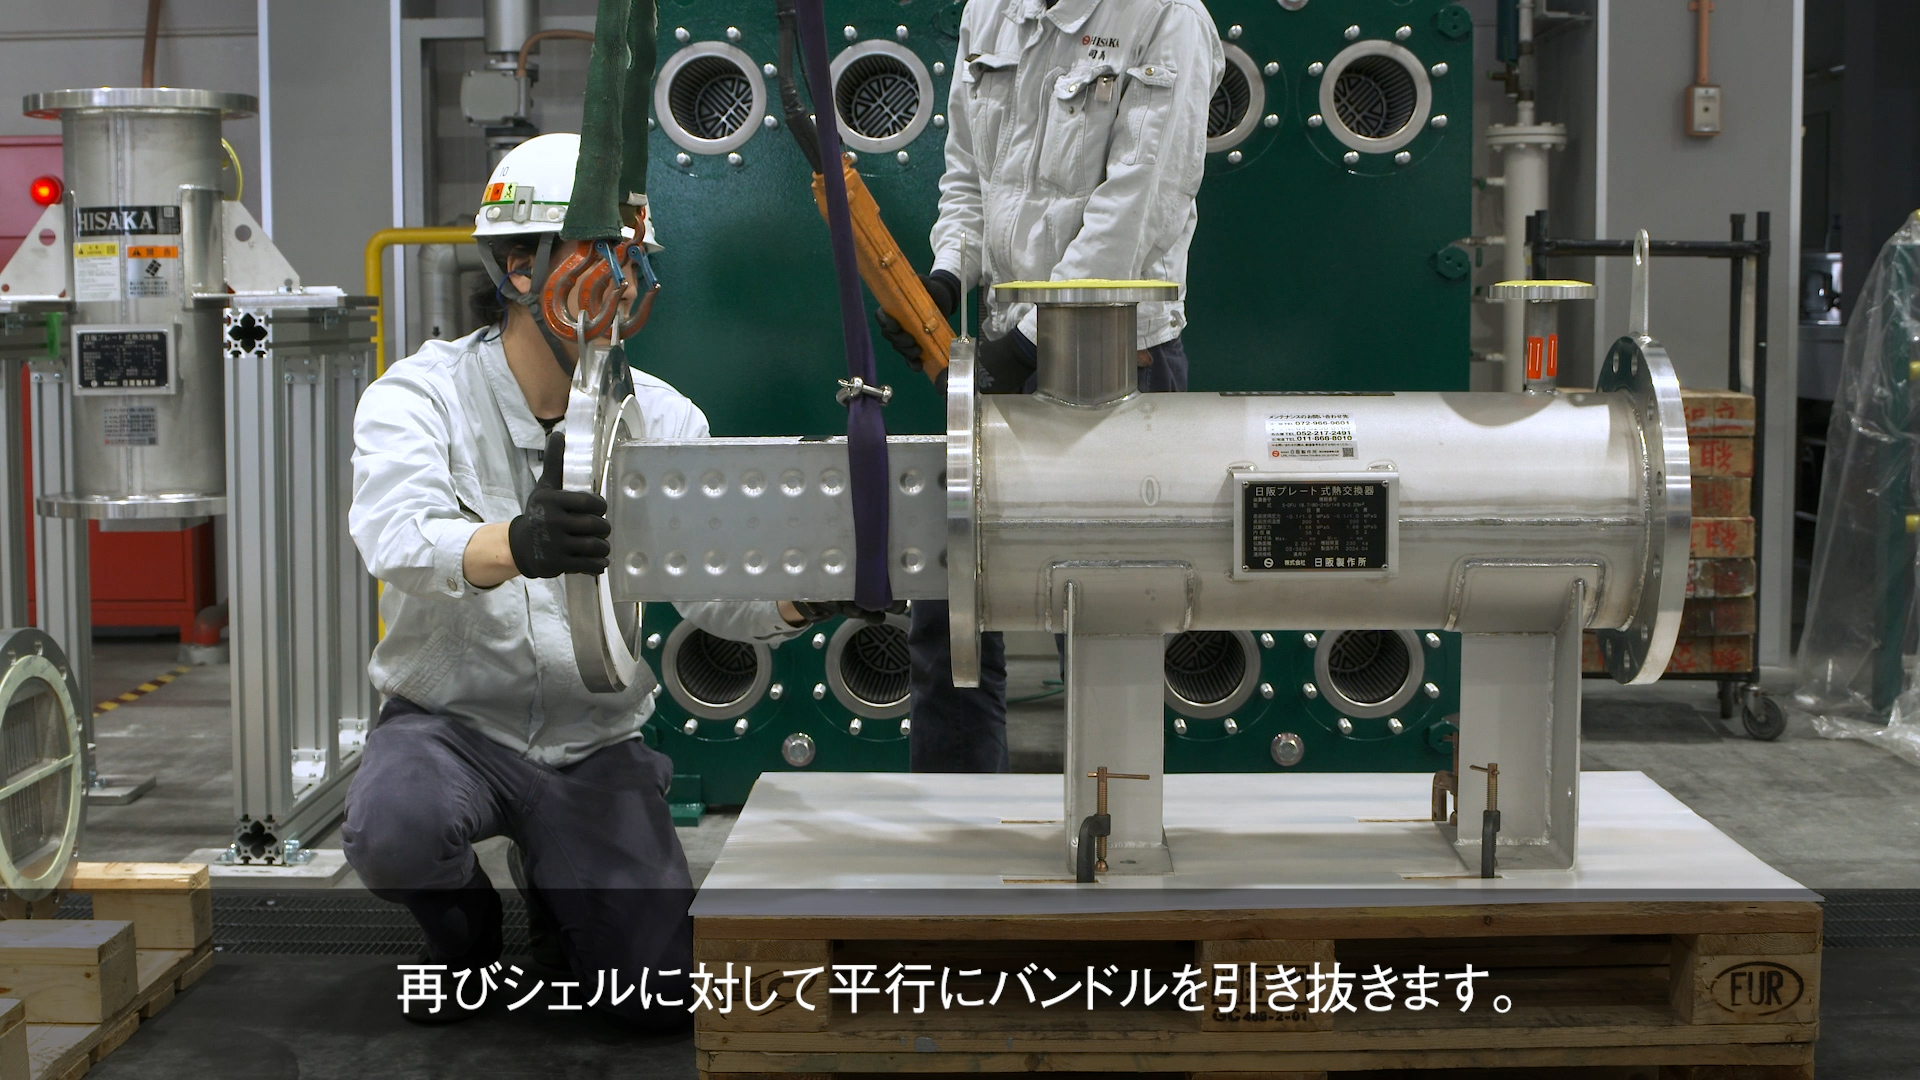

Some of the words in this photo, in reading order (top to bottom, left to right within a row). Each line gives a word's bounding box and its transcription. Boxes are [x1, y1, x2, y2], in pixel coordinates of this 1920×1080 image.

[78, 211, 154, 231] HISAKA
[1255, 486, 1375, 497] 日阪プレート式熱交換器
[1315, 557, 1367, 567] 日阪製作所
[1730, 970, 1784, 1007] EUR
